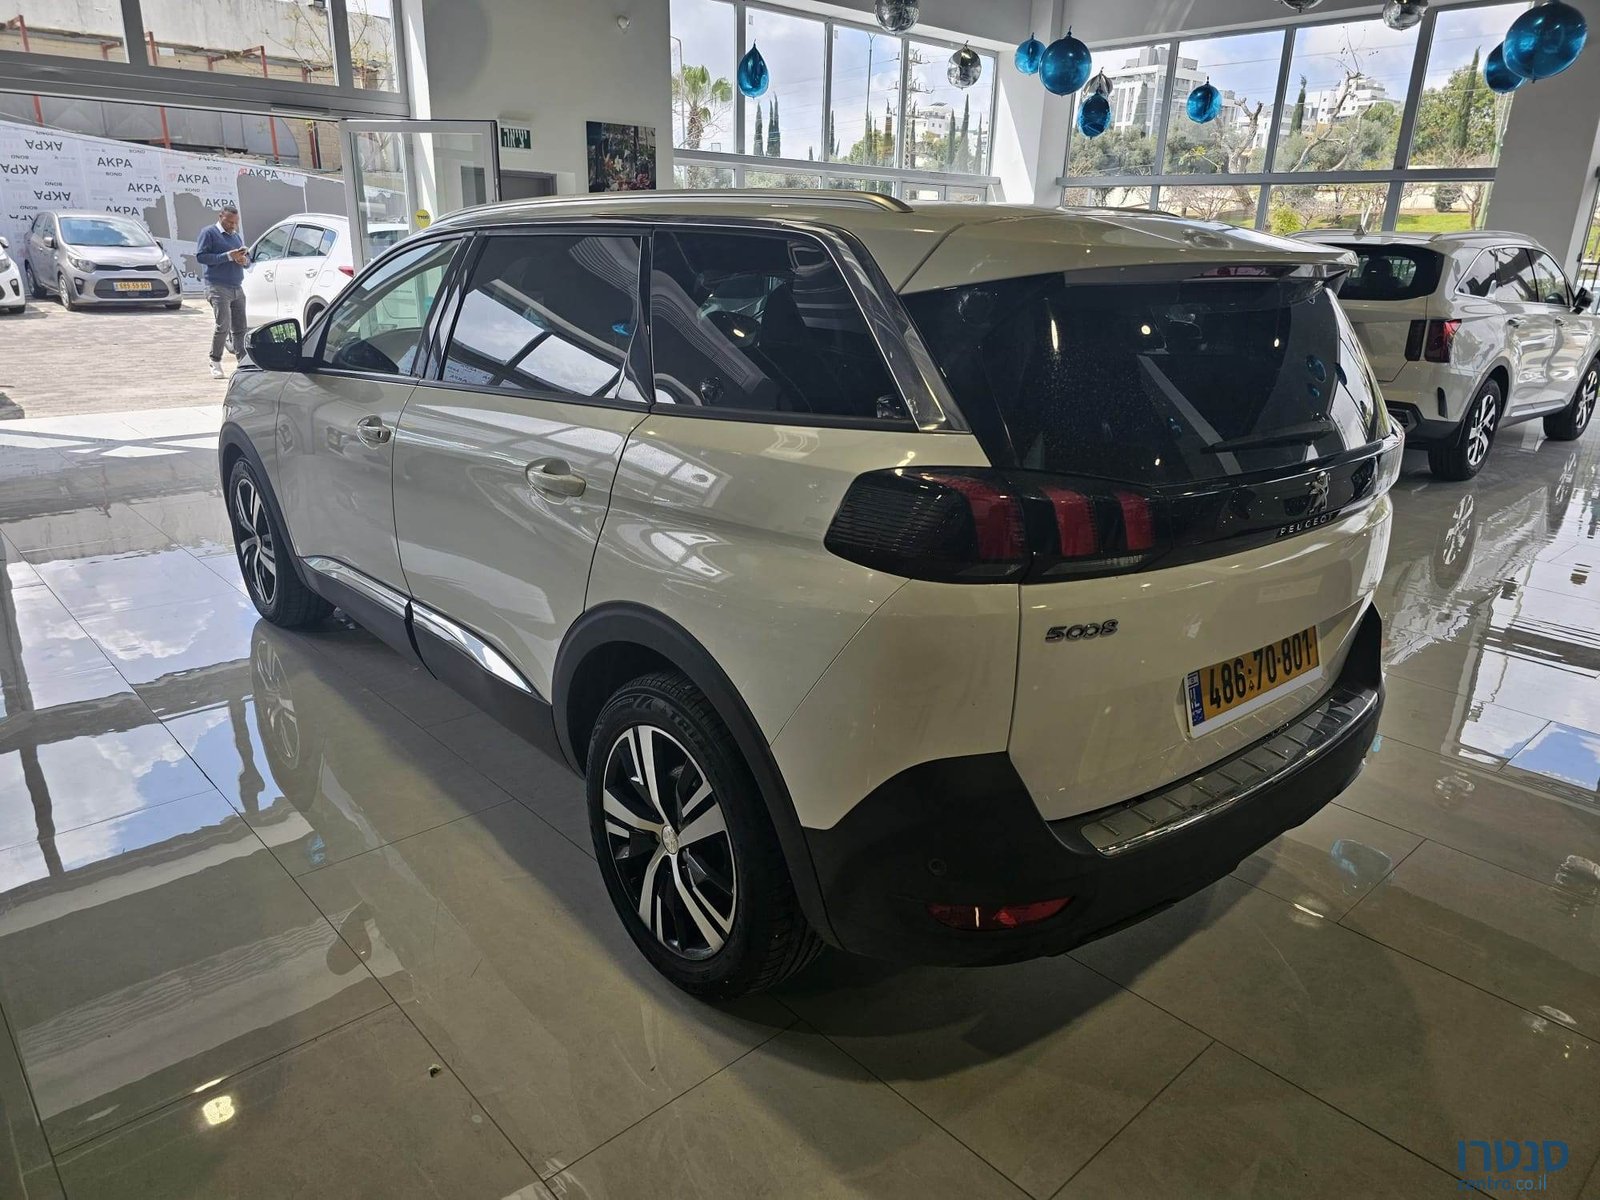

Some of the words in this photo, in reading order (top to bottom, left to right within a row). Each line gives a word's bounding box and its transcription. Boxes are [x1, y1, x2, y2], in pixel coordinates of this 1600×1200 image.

[503, 128, 528, 149] יציאה
[25, 139, 63, 151] AKPA
[97, 157, 133, 168] AKPA
[177, 173, 210, 185] AKPA
[248, 168, 279, 179] AKPA
[127, 182, 162, 194] AKPA
[33, 190, 71, 201] AKPA
[1044, 618, 1119, 643] 5008
